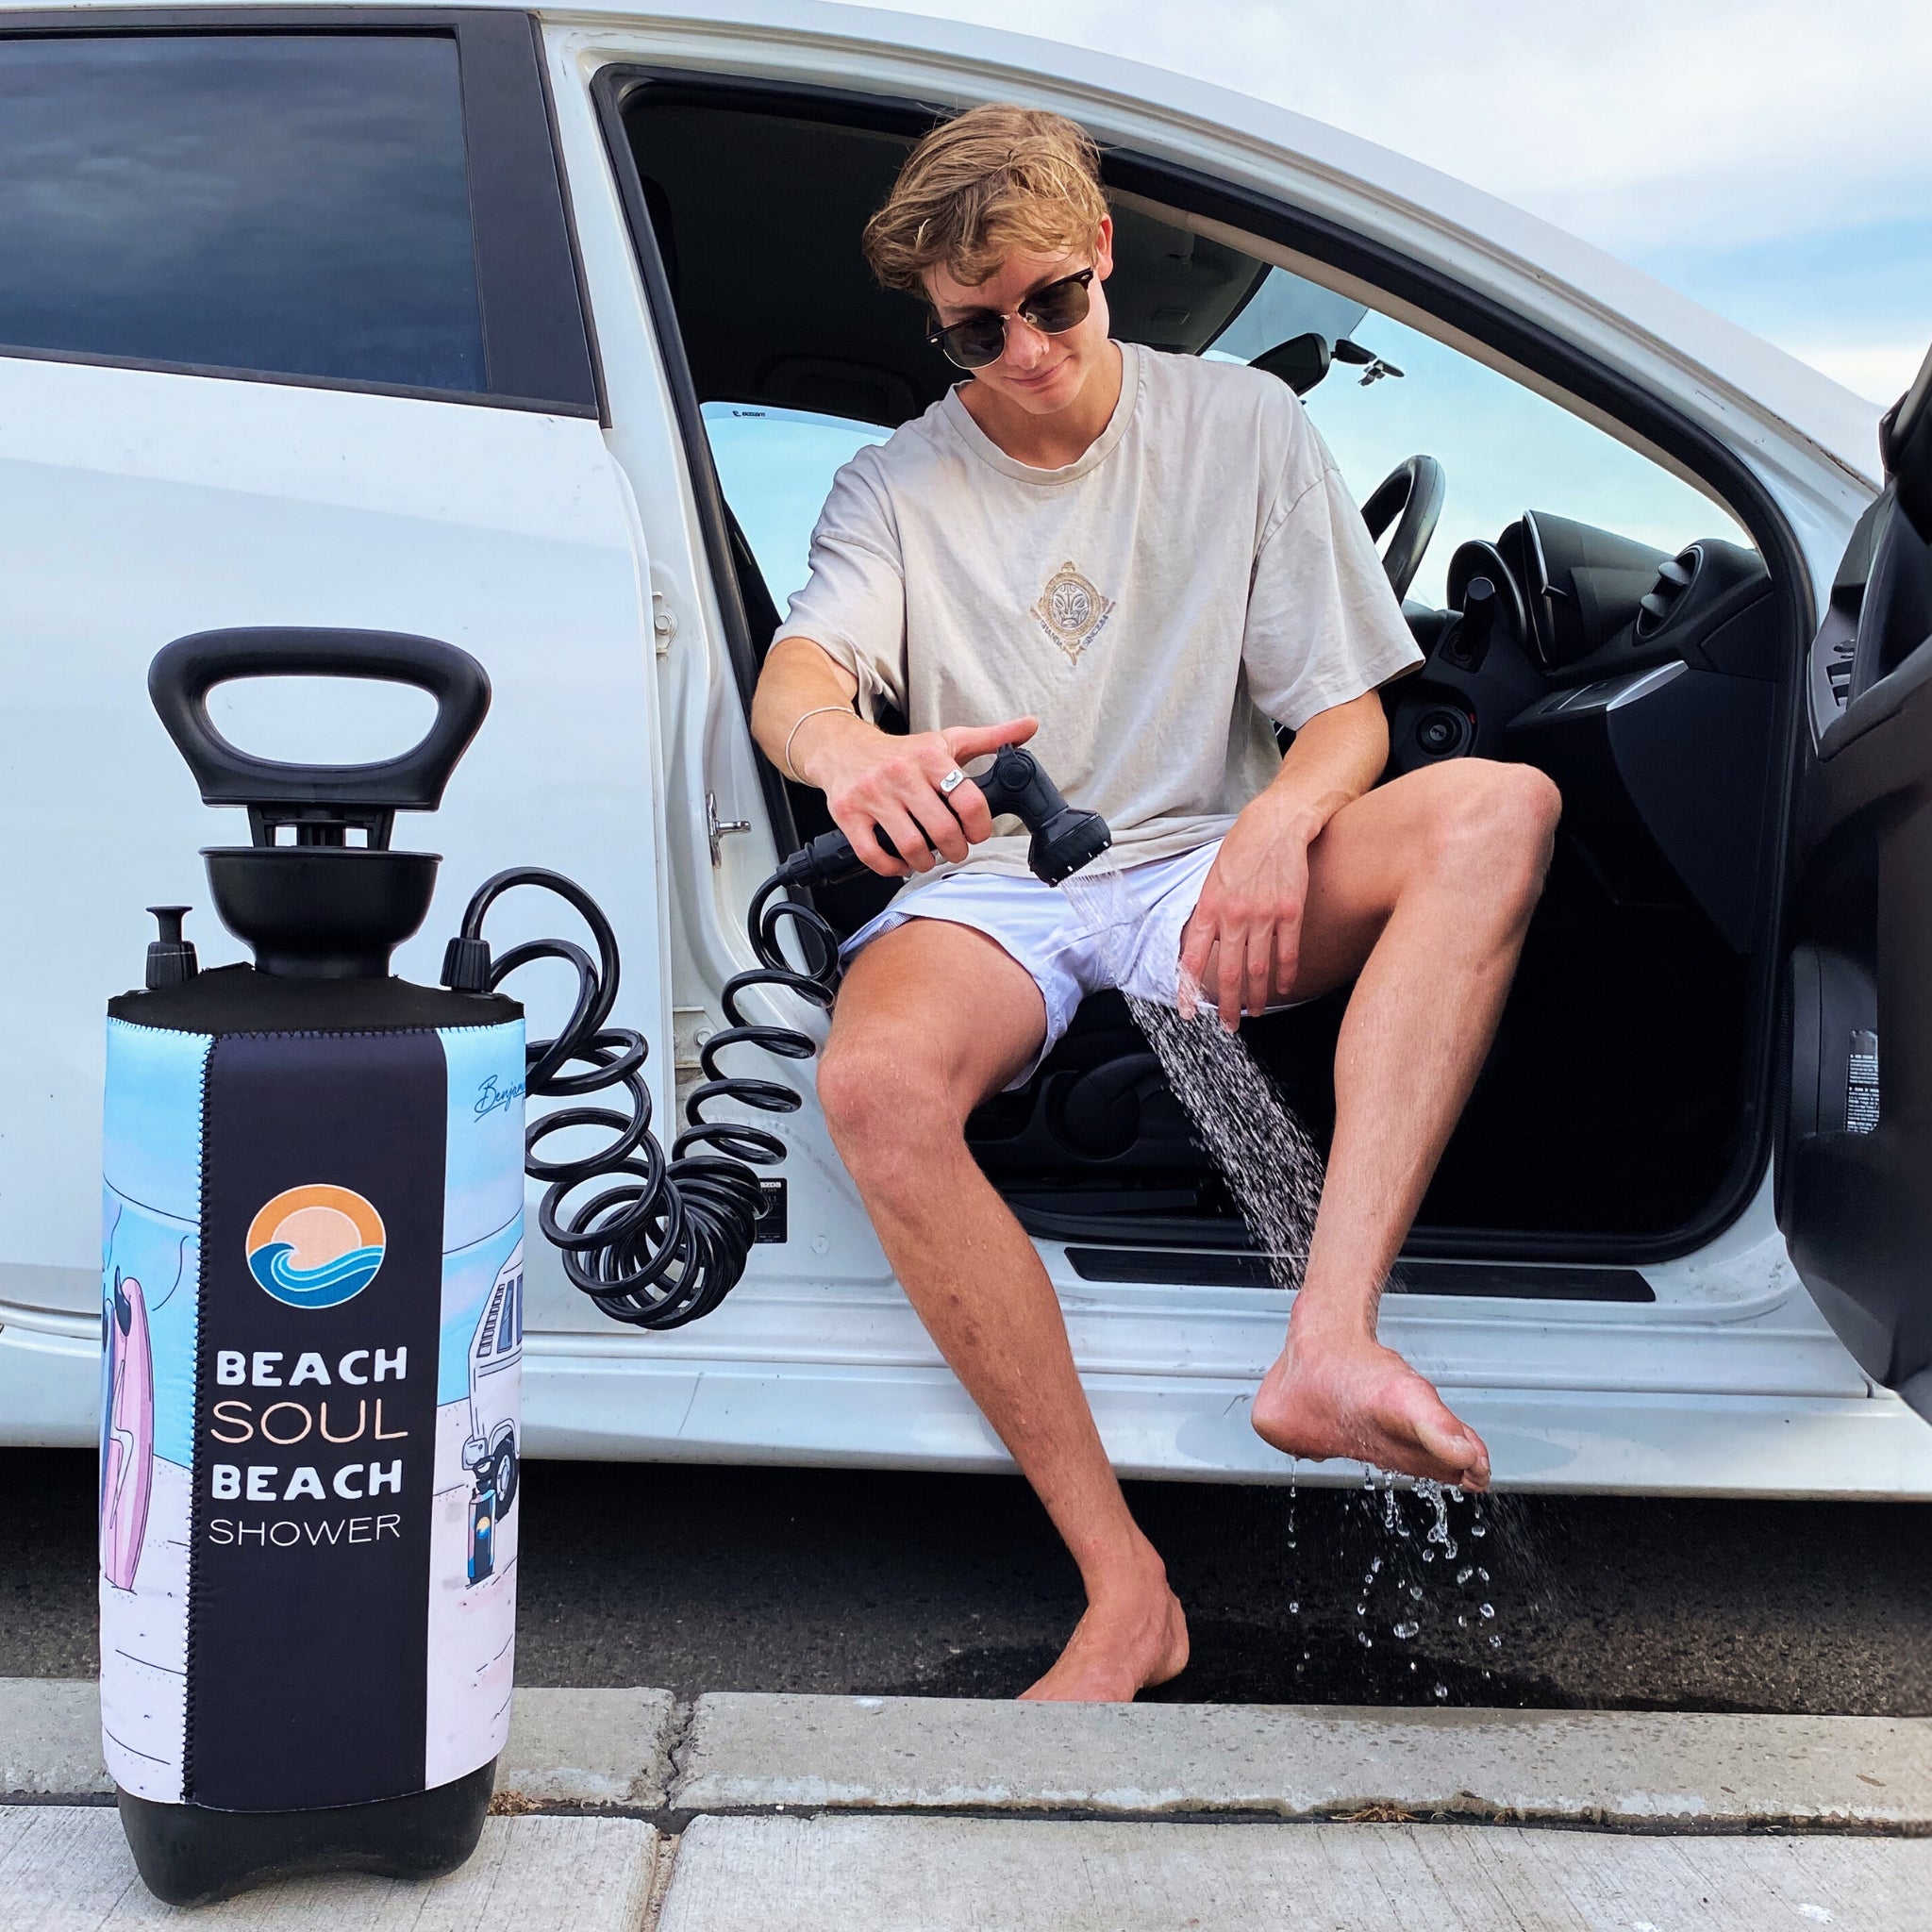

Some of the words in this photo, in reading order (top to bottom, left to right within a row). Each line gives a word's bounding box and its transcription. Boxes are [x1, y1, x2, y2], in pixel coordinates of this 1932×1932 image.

[216, 1346, 408, 1387] BEACH
[210, 1398, 408, 1445] SOUL
[211, 1459, 403, 1502] BEACH
[208, 1513, 401, 1547] SHOWER
